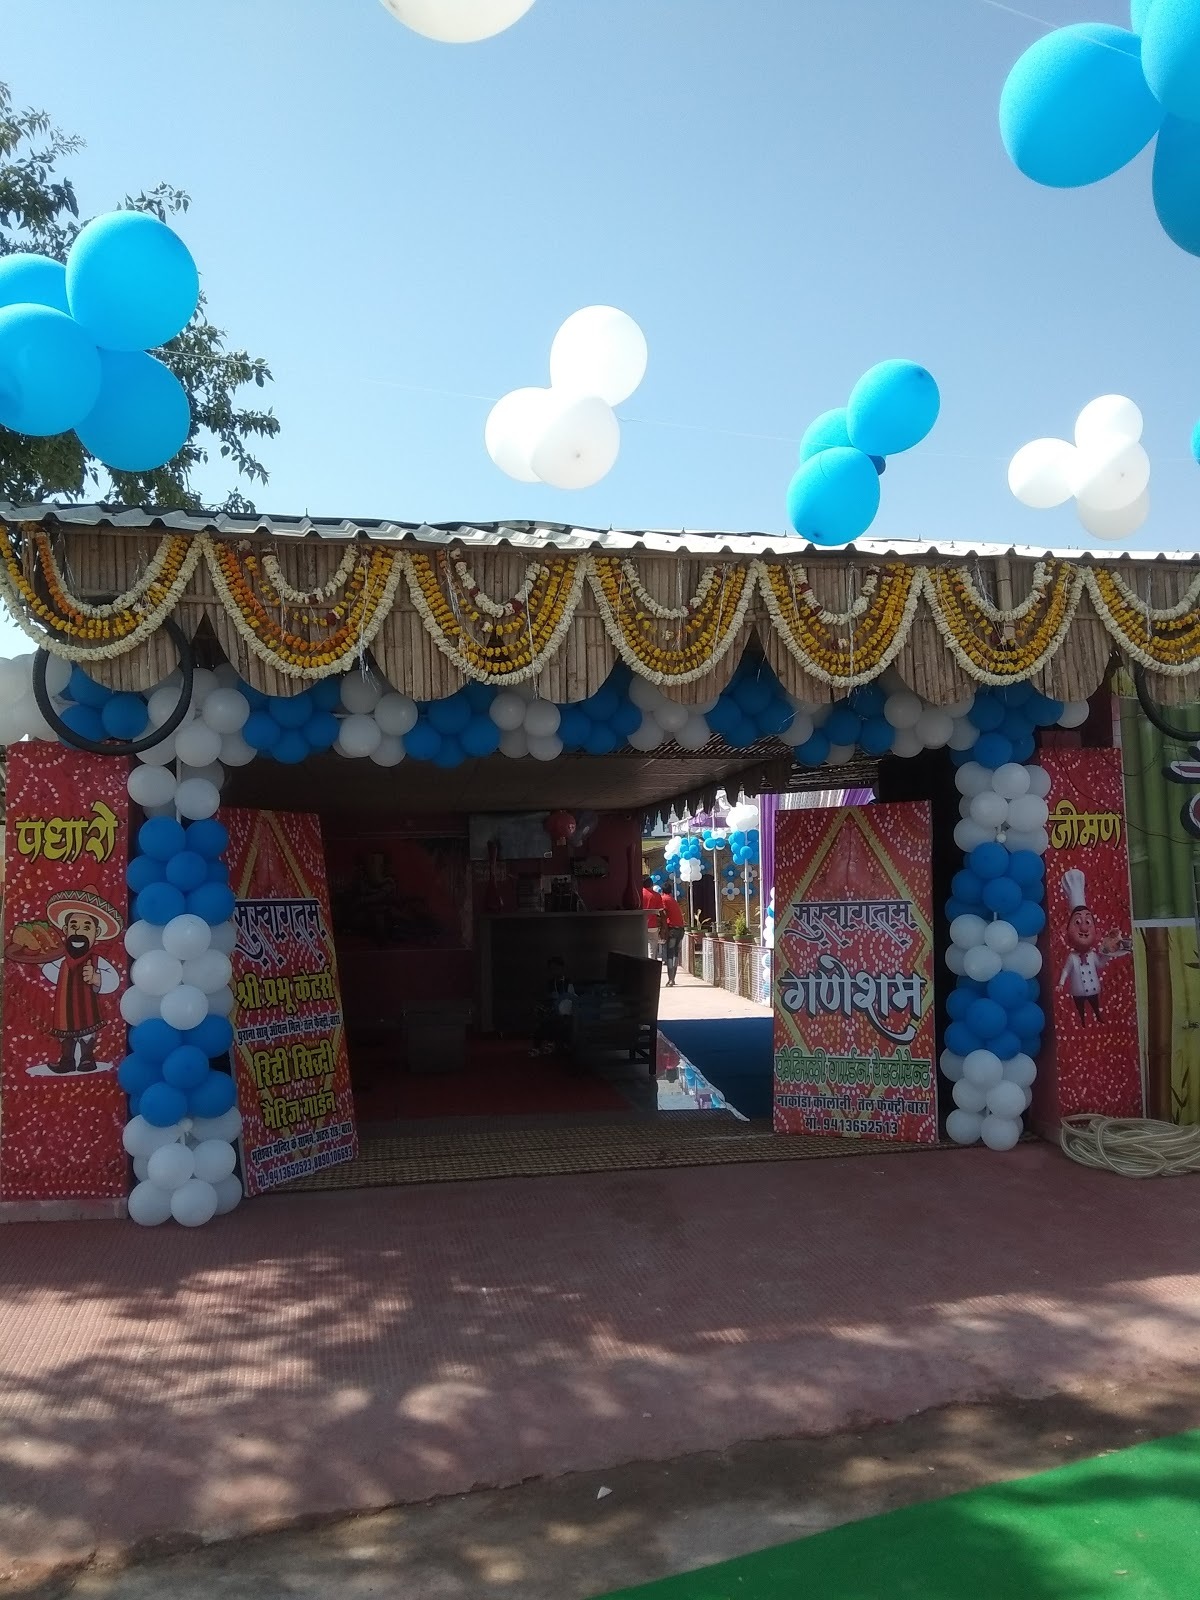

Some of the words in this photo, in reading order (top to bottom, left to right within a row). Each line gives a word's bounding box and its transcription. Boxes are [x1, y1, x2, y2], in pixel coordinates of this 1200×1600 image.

[15, 799, 119, 863] पधारो
[1048, 798, 1123, 850] जीमण
[235, 971, 262, 1010] श्री
[777, 953, 927, 1045] गणेशम
[827, 1045, 870, 1086] गार्डन
[259, 1096, 302, 1130] मैरिज
[301, 1086, 337, 1120] गार्डन
[857, 1094, 875, 1111] तेल
[906, 1097, 931, 1115] बारां
[823, 1117, 899, 1135] 9413652513
